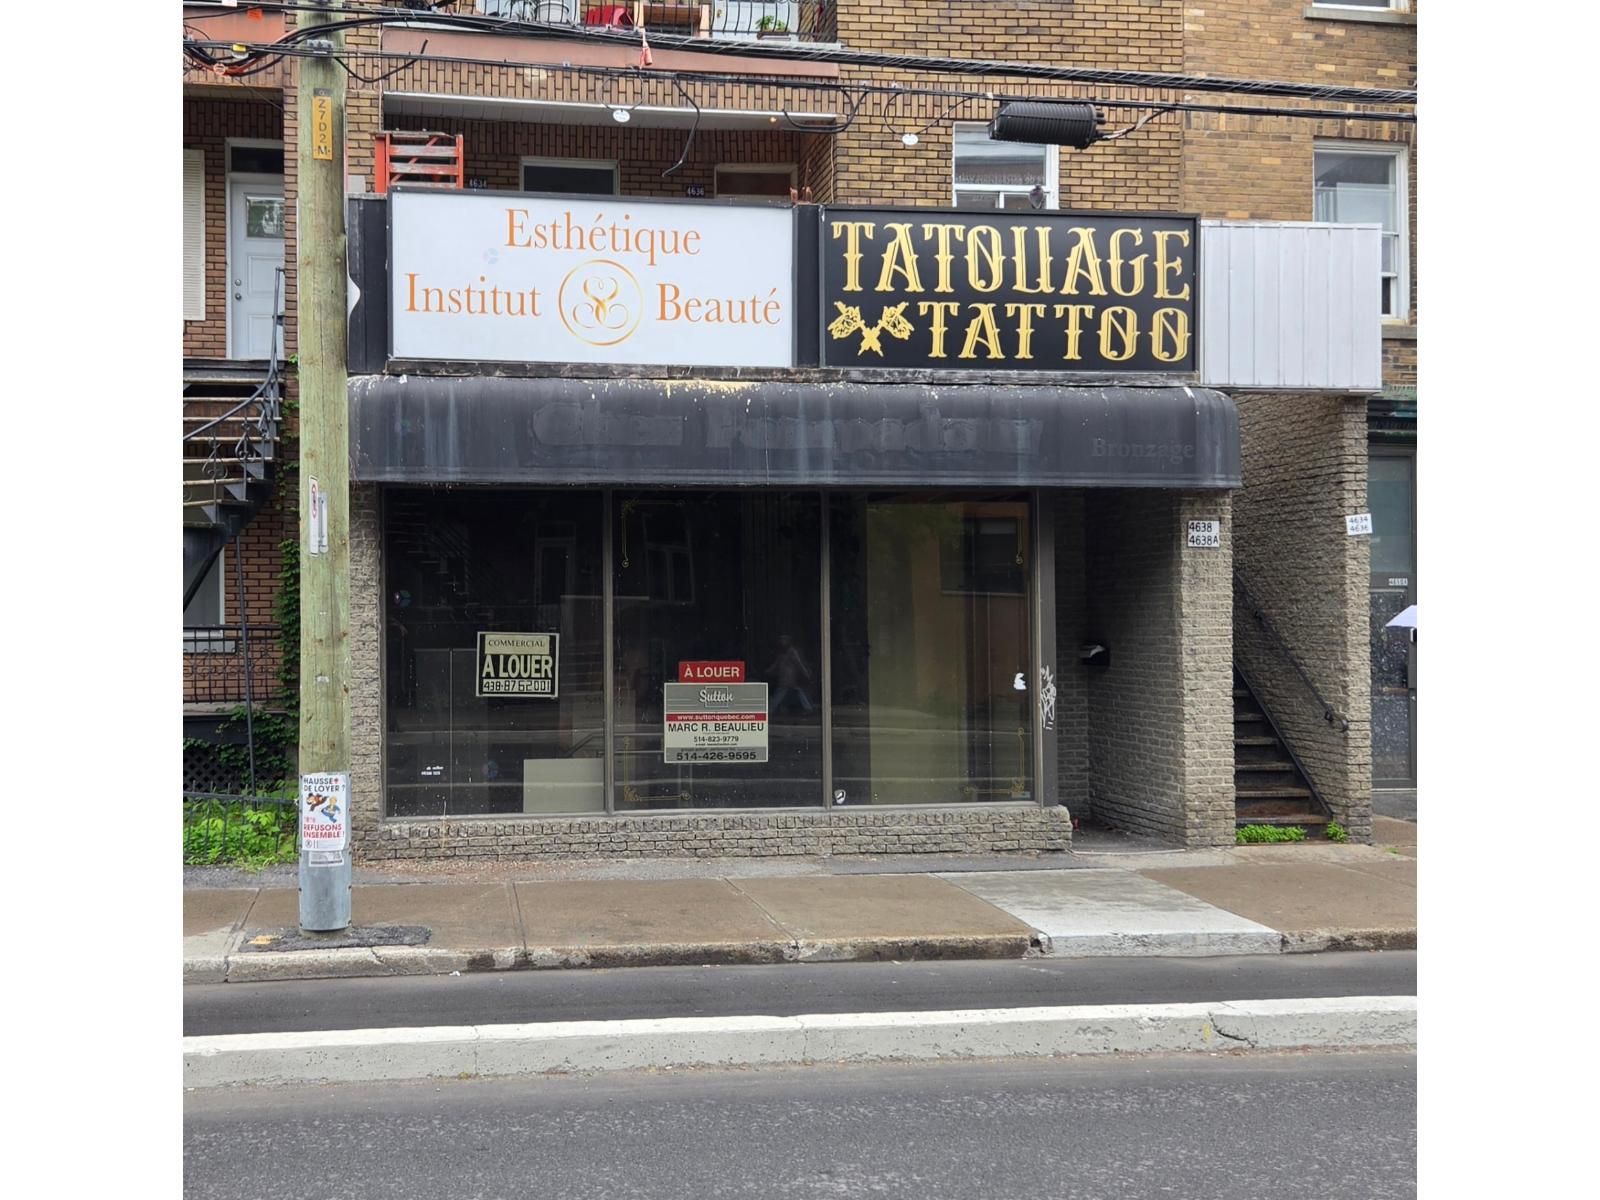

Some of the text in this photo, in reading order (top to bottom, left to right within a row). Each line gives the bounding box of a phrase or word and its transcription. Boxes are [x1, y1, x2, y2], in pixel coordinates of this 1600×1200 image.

[504, 208, 701, 266] Esthétique
[830, 221, 1191, 302] TATOUAGE
[404, 272, 782, 326] Institut Beauté
[917, 300, 1193, 363] TATTOO
[1091, 438, 1196, 464] Bronzage
[1189, 521, 1213, 533] 4638
[1189, 535, 1219, 546] 4638A
[499, 654, 553, 679] LOUER
[684, 664, 740, 678] À LOUER
[699, 688, 734, 703] Sutton
[668, 722, 764, 732] MARC R. BEAULIEU
[676, 752, 756, 760] 514-426-9595
[303, 777, 333, 785] HAUSSE
[303, 824, 342, 832] REFUSONS
[303, 831, 342, 839] ENSEMBLE
